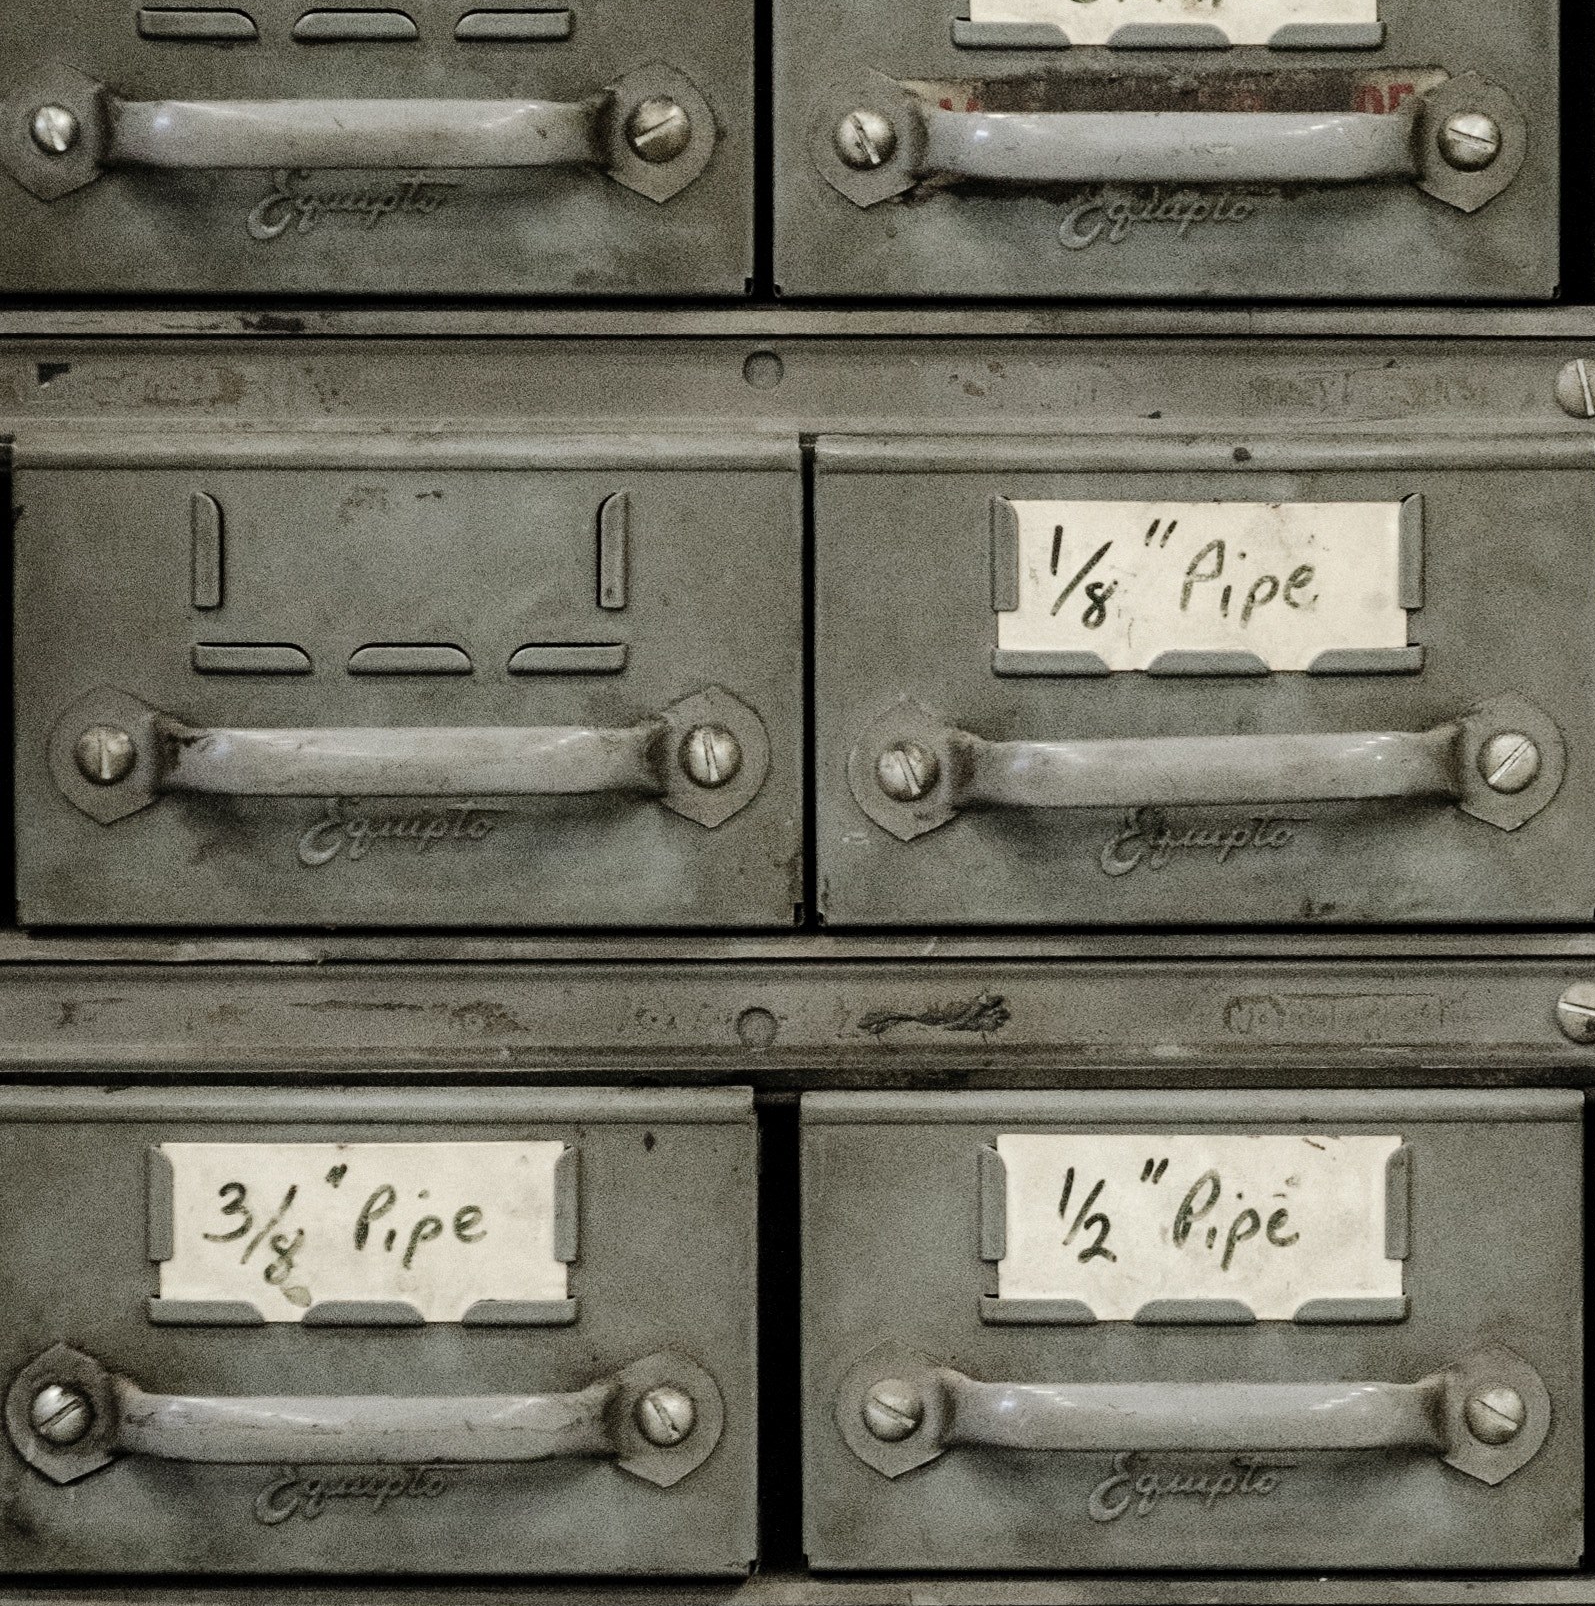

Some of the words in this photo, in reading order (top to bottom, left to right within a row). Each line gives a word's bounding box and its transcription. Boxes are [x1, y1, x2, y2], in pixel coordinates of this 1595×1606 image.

[1179, 539, 1319, 628] Pipe
[354, 1184, 489, 1270] Pipe
[1173, 1170, 1300, 1271] Pipe
